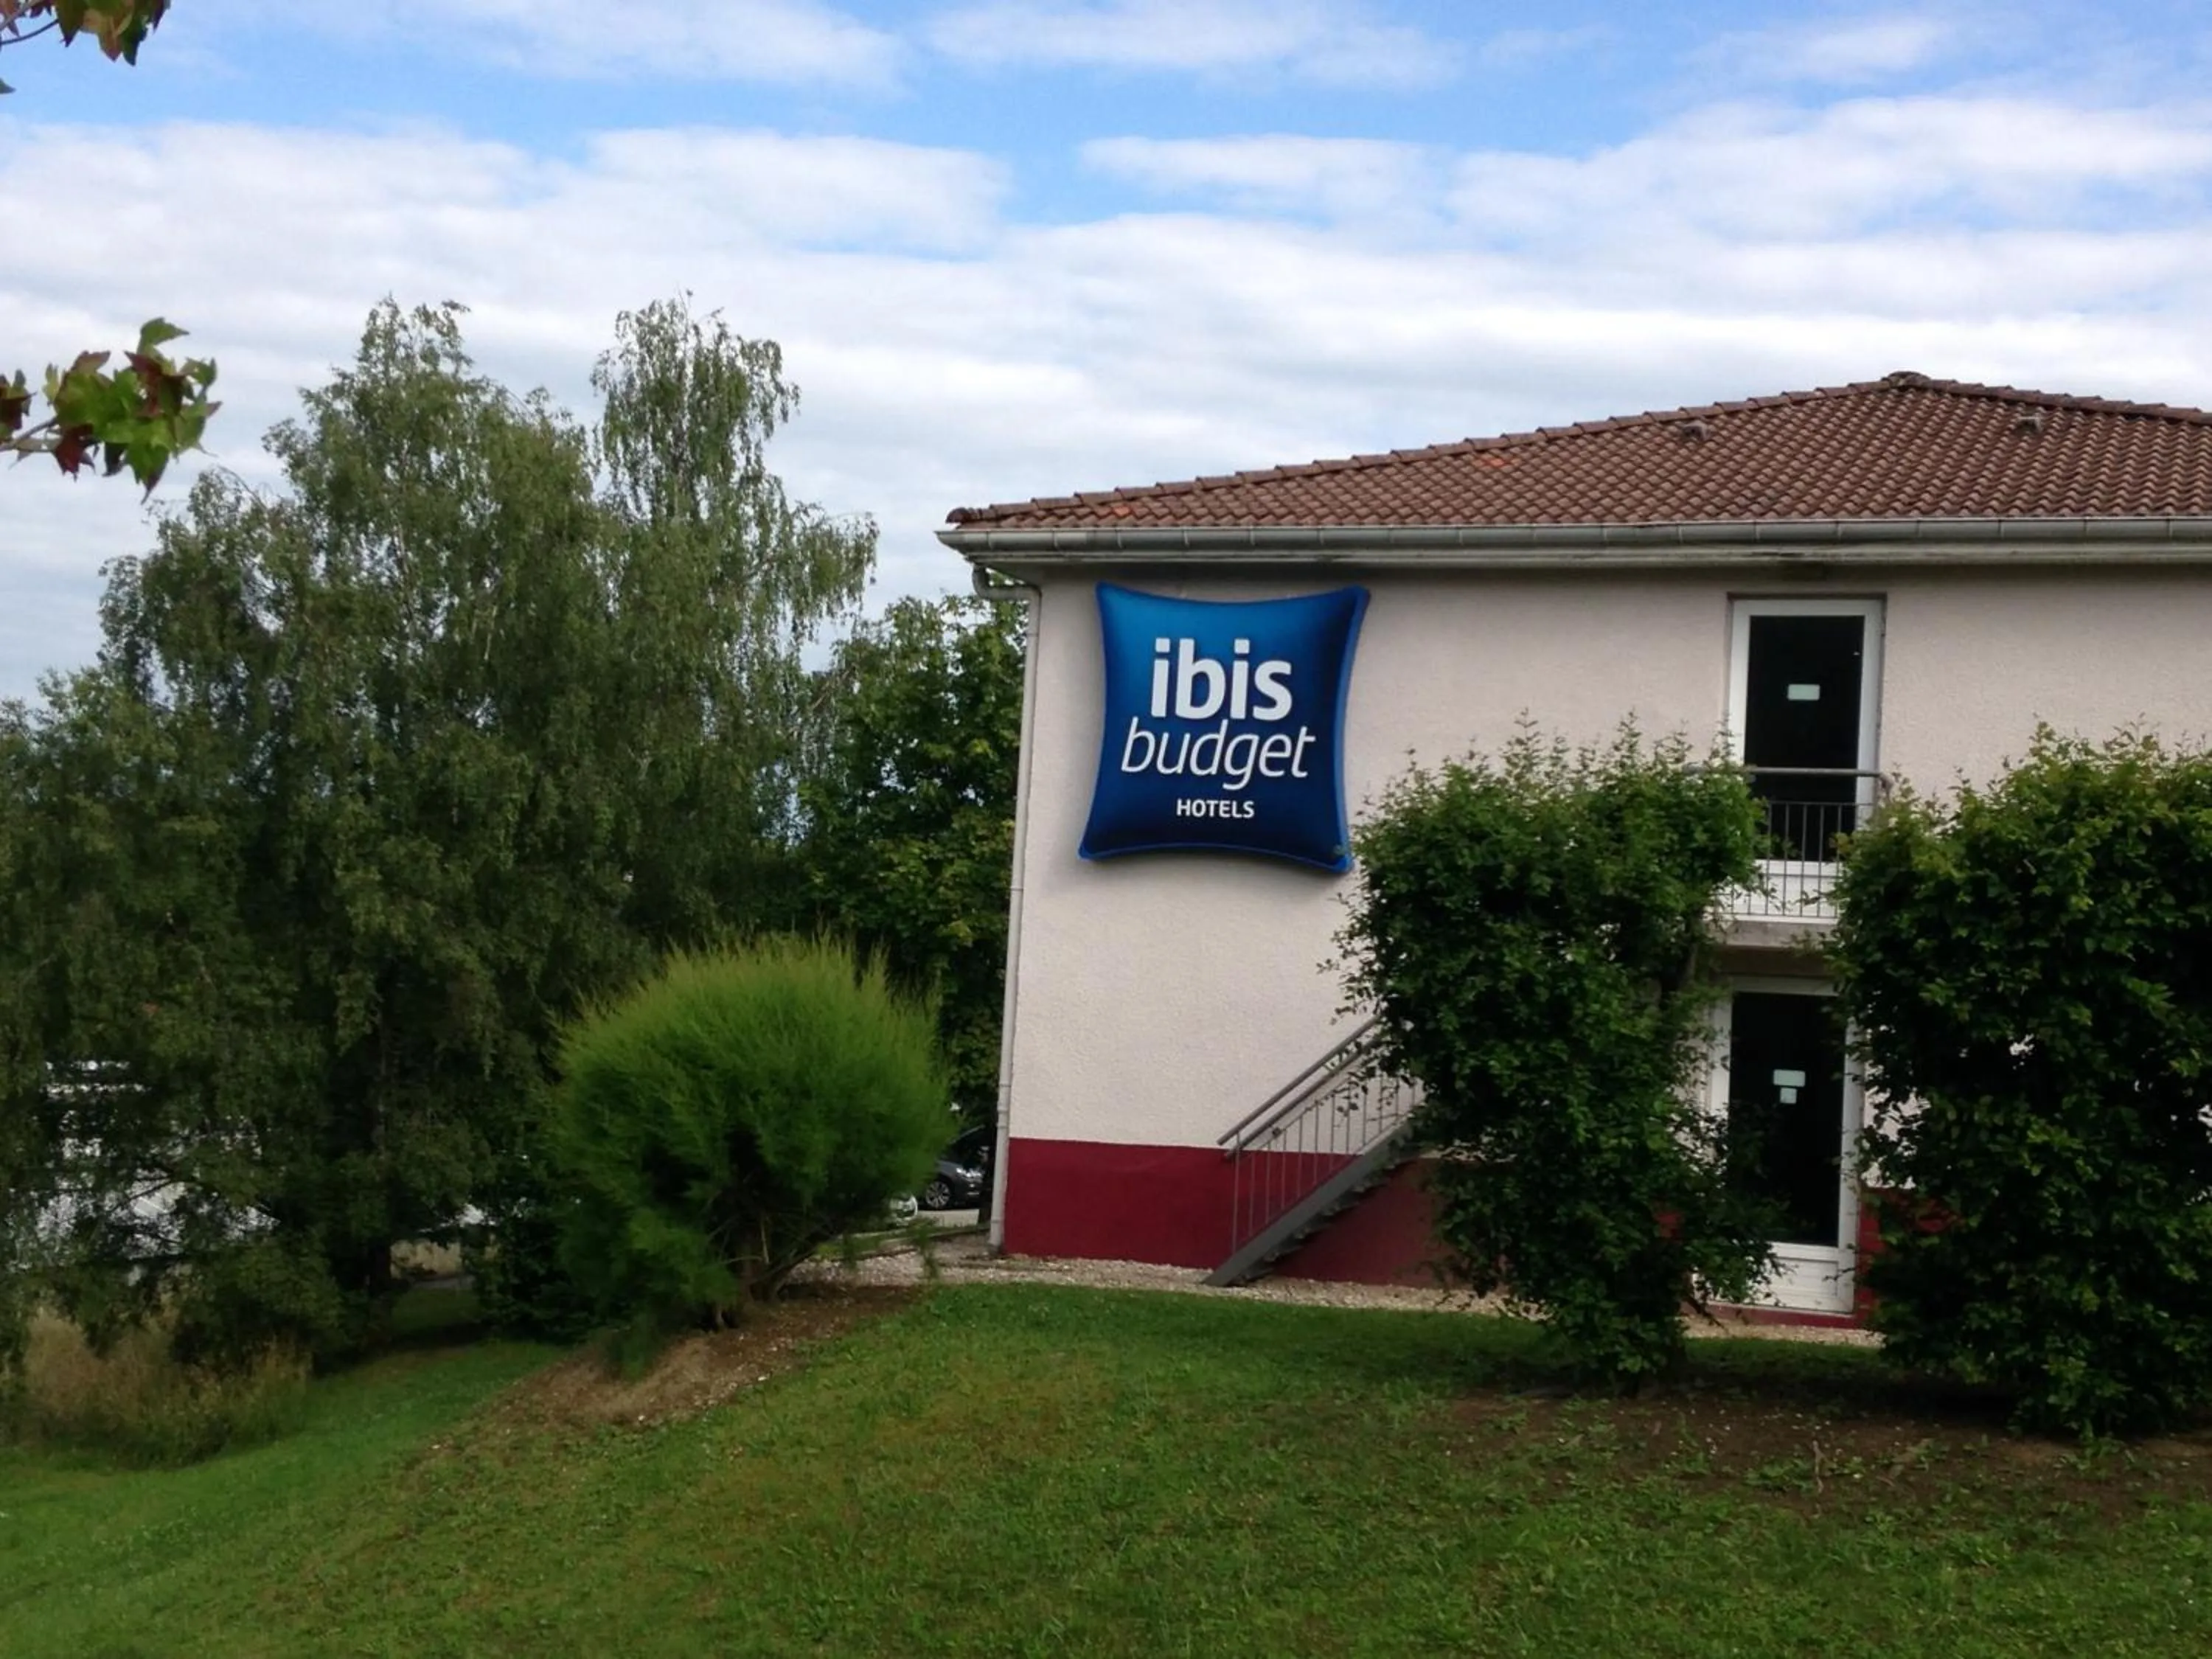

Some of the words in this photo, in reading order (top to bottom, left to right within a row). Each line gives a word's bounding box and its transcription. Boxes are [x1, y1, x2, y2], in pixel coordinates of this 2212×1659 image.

[1150, 637, 1293, 721] ibis
[1121, 716, 1316, 791] budget
[1176, 799, 1255, 818] HOTELS
